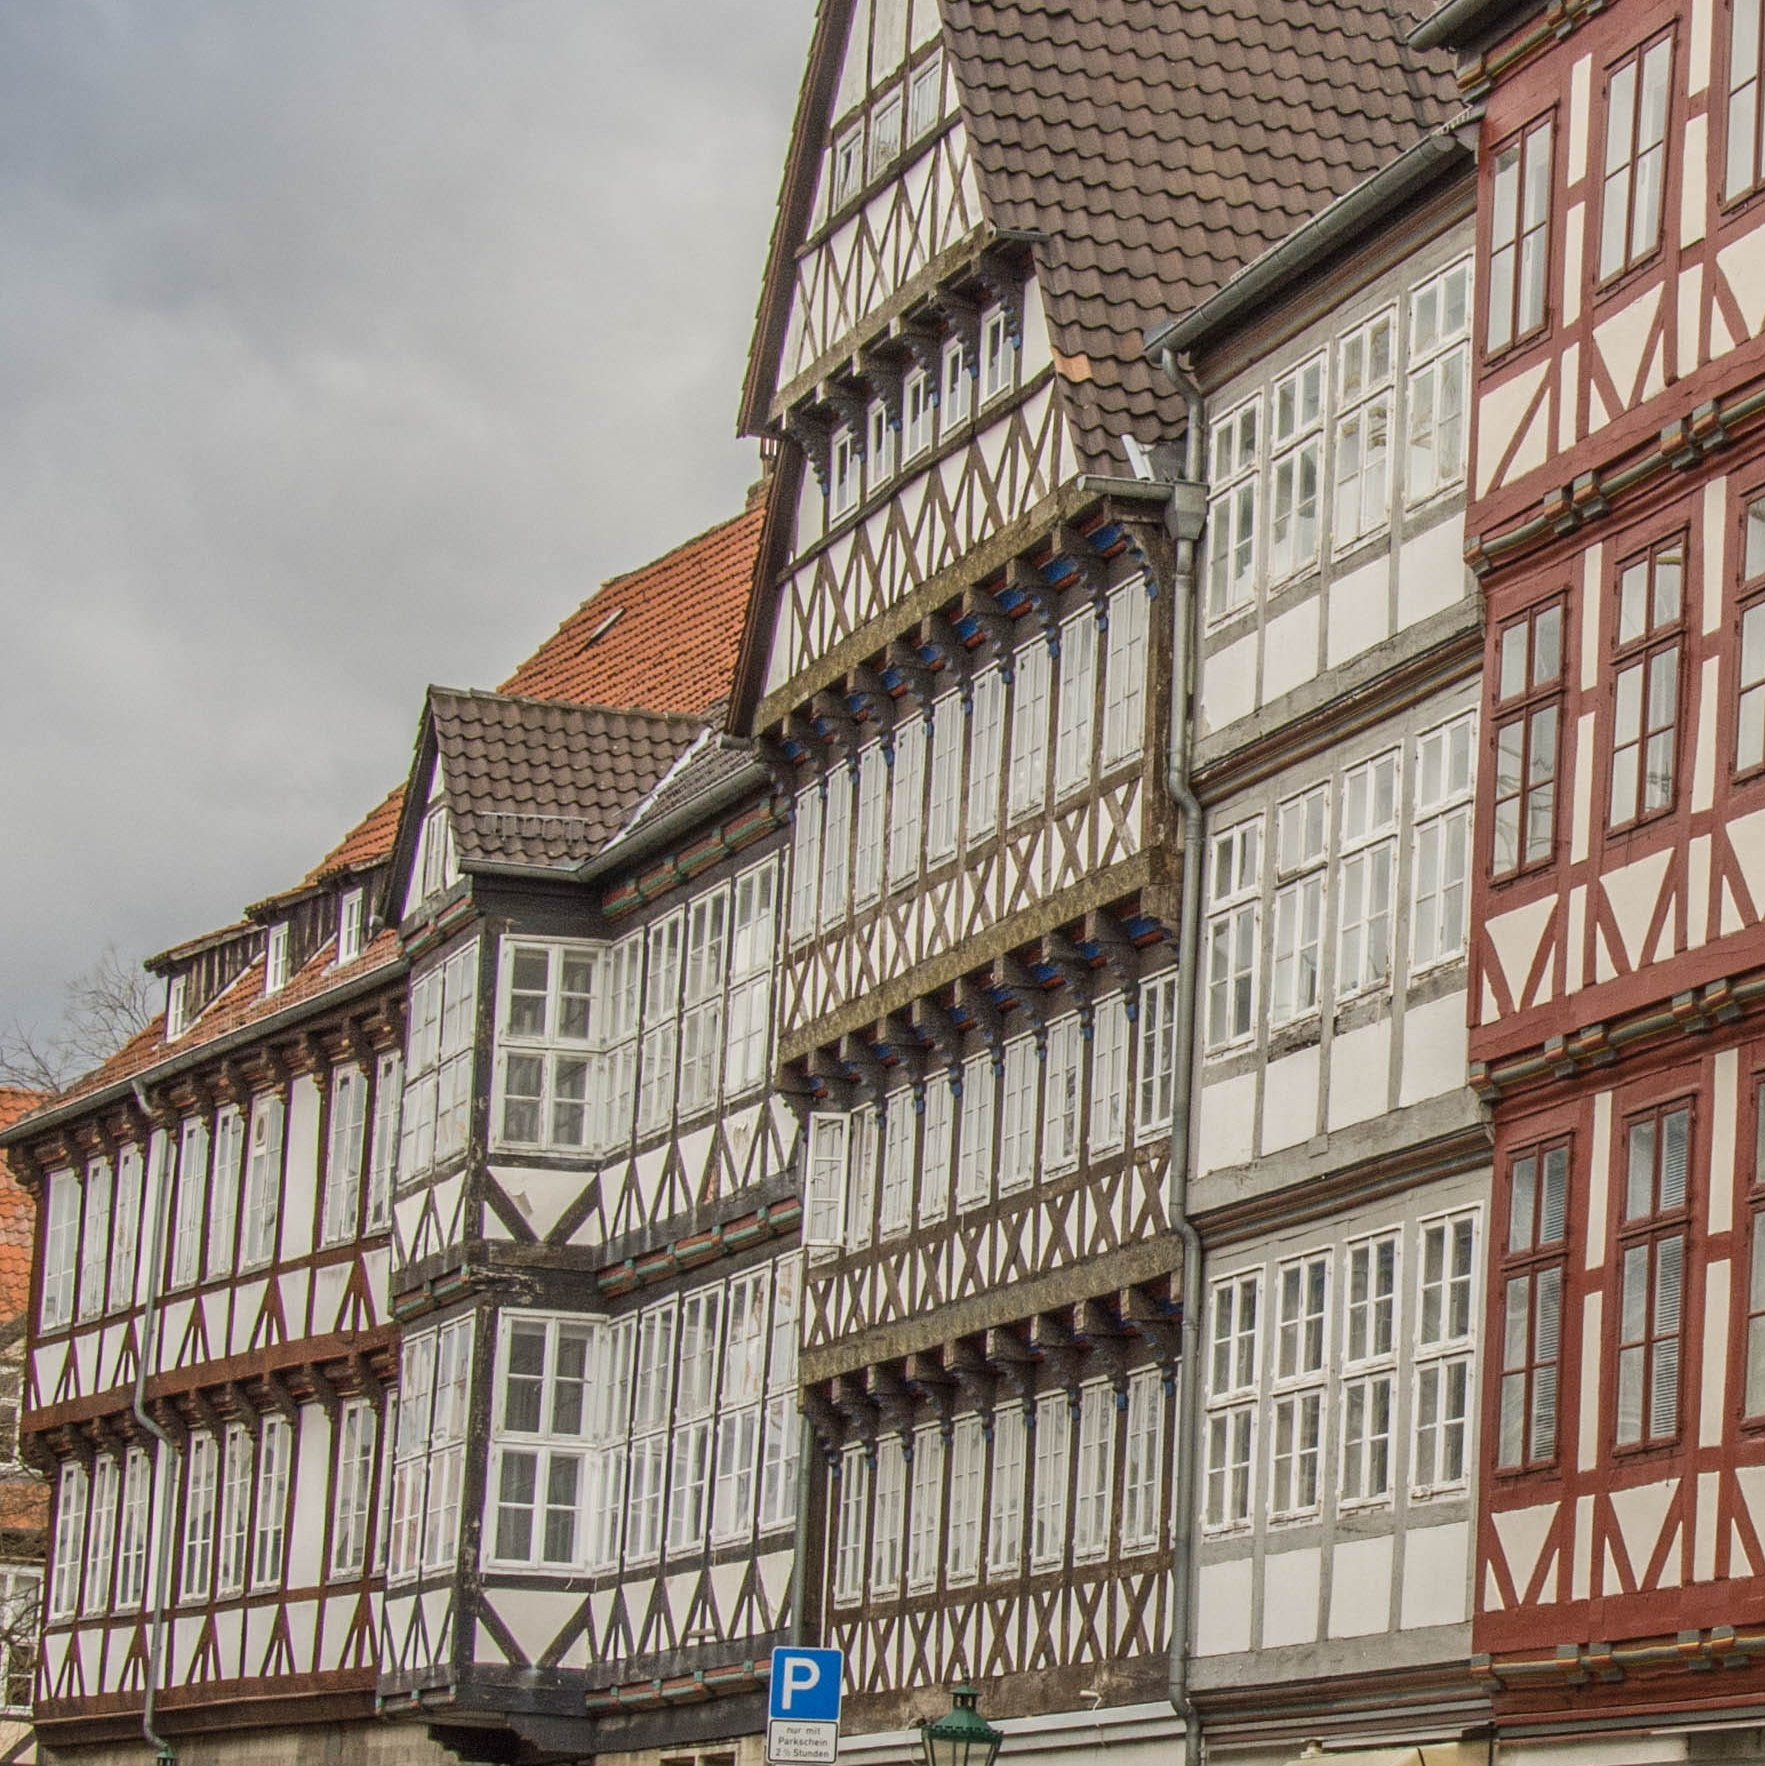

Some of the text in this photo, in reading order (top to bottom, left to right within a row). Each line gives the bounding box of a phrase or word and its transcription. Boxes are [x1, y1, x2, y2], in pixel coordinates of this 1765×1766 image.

[782, 1657, 820, 1710] P
[778, 1736, 828, 1746] Parkschein
[793, 1748, 830, 1758] Stunden
